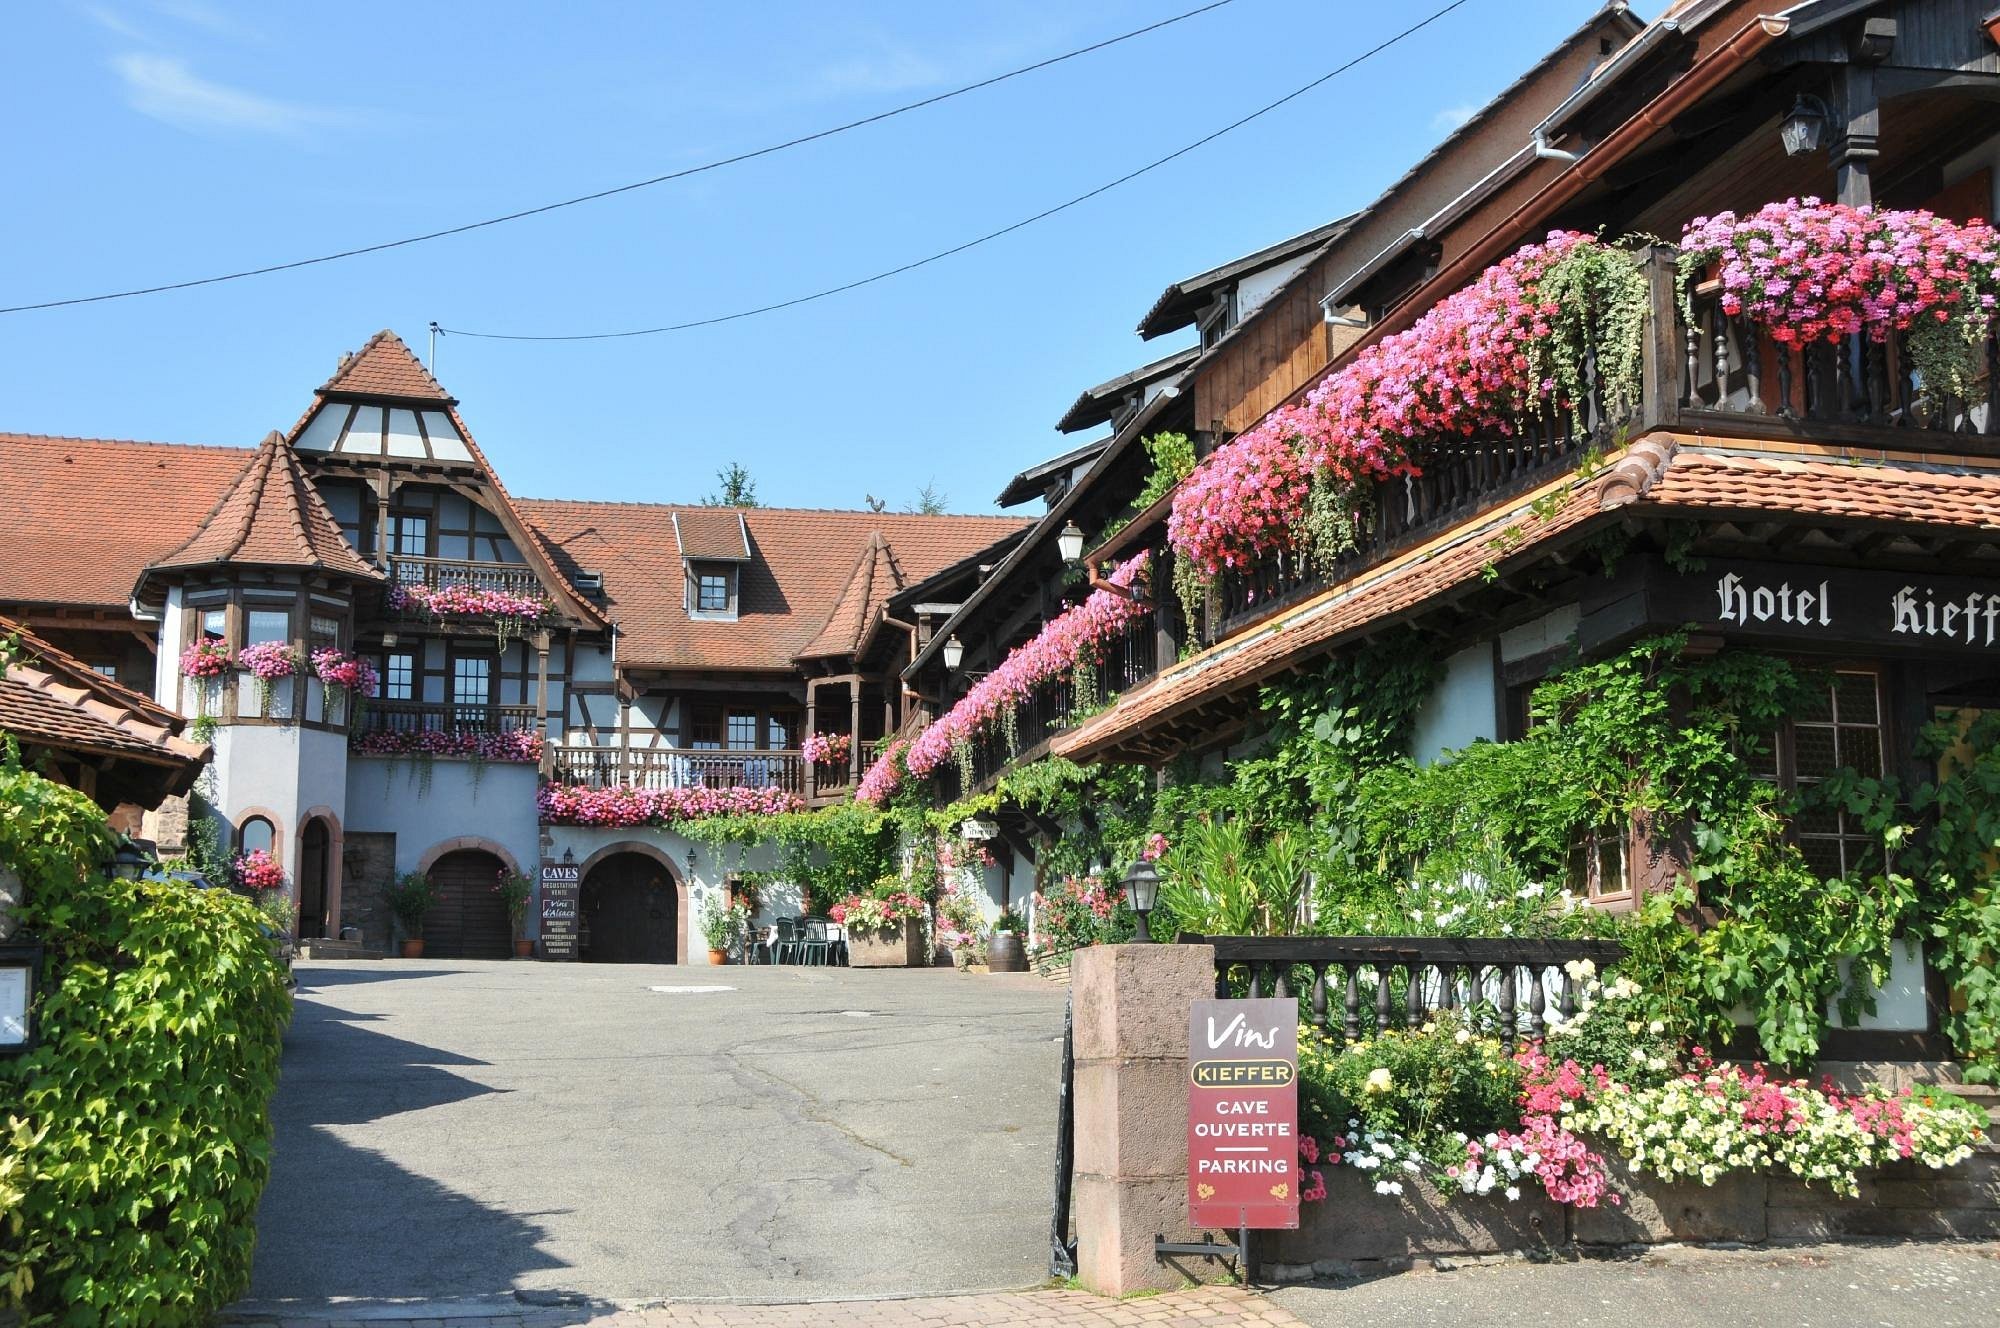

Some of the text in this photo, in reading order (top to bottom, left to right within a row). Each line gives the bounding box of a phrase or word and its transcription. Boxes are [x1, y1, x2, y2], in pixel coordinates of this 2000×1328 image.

[1716, 572, 2000, 647] Hotel Kieff
[543, 867, 578, 879] CAVES
[1207, 1012, 1280, 1050] Vins
[1198, 1066, 1290, 1081] KIEFFER
[1216, 1100, 1269, 1115] CAVE
[1195, 1123, 1290, 1137] OUVERTE
[1198, 1159, 1288, 1173] PARKING
